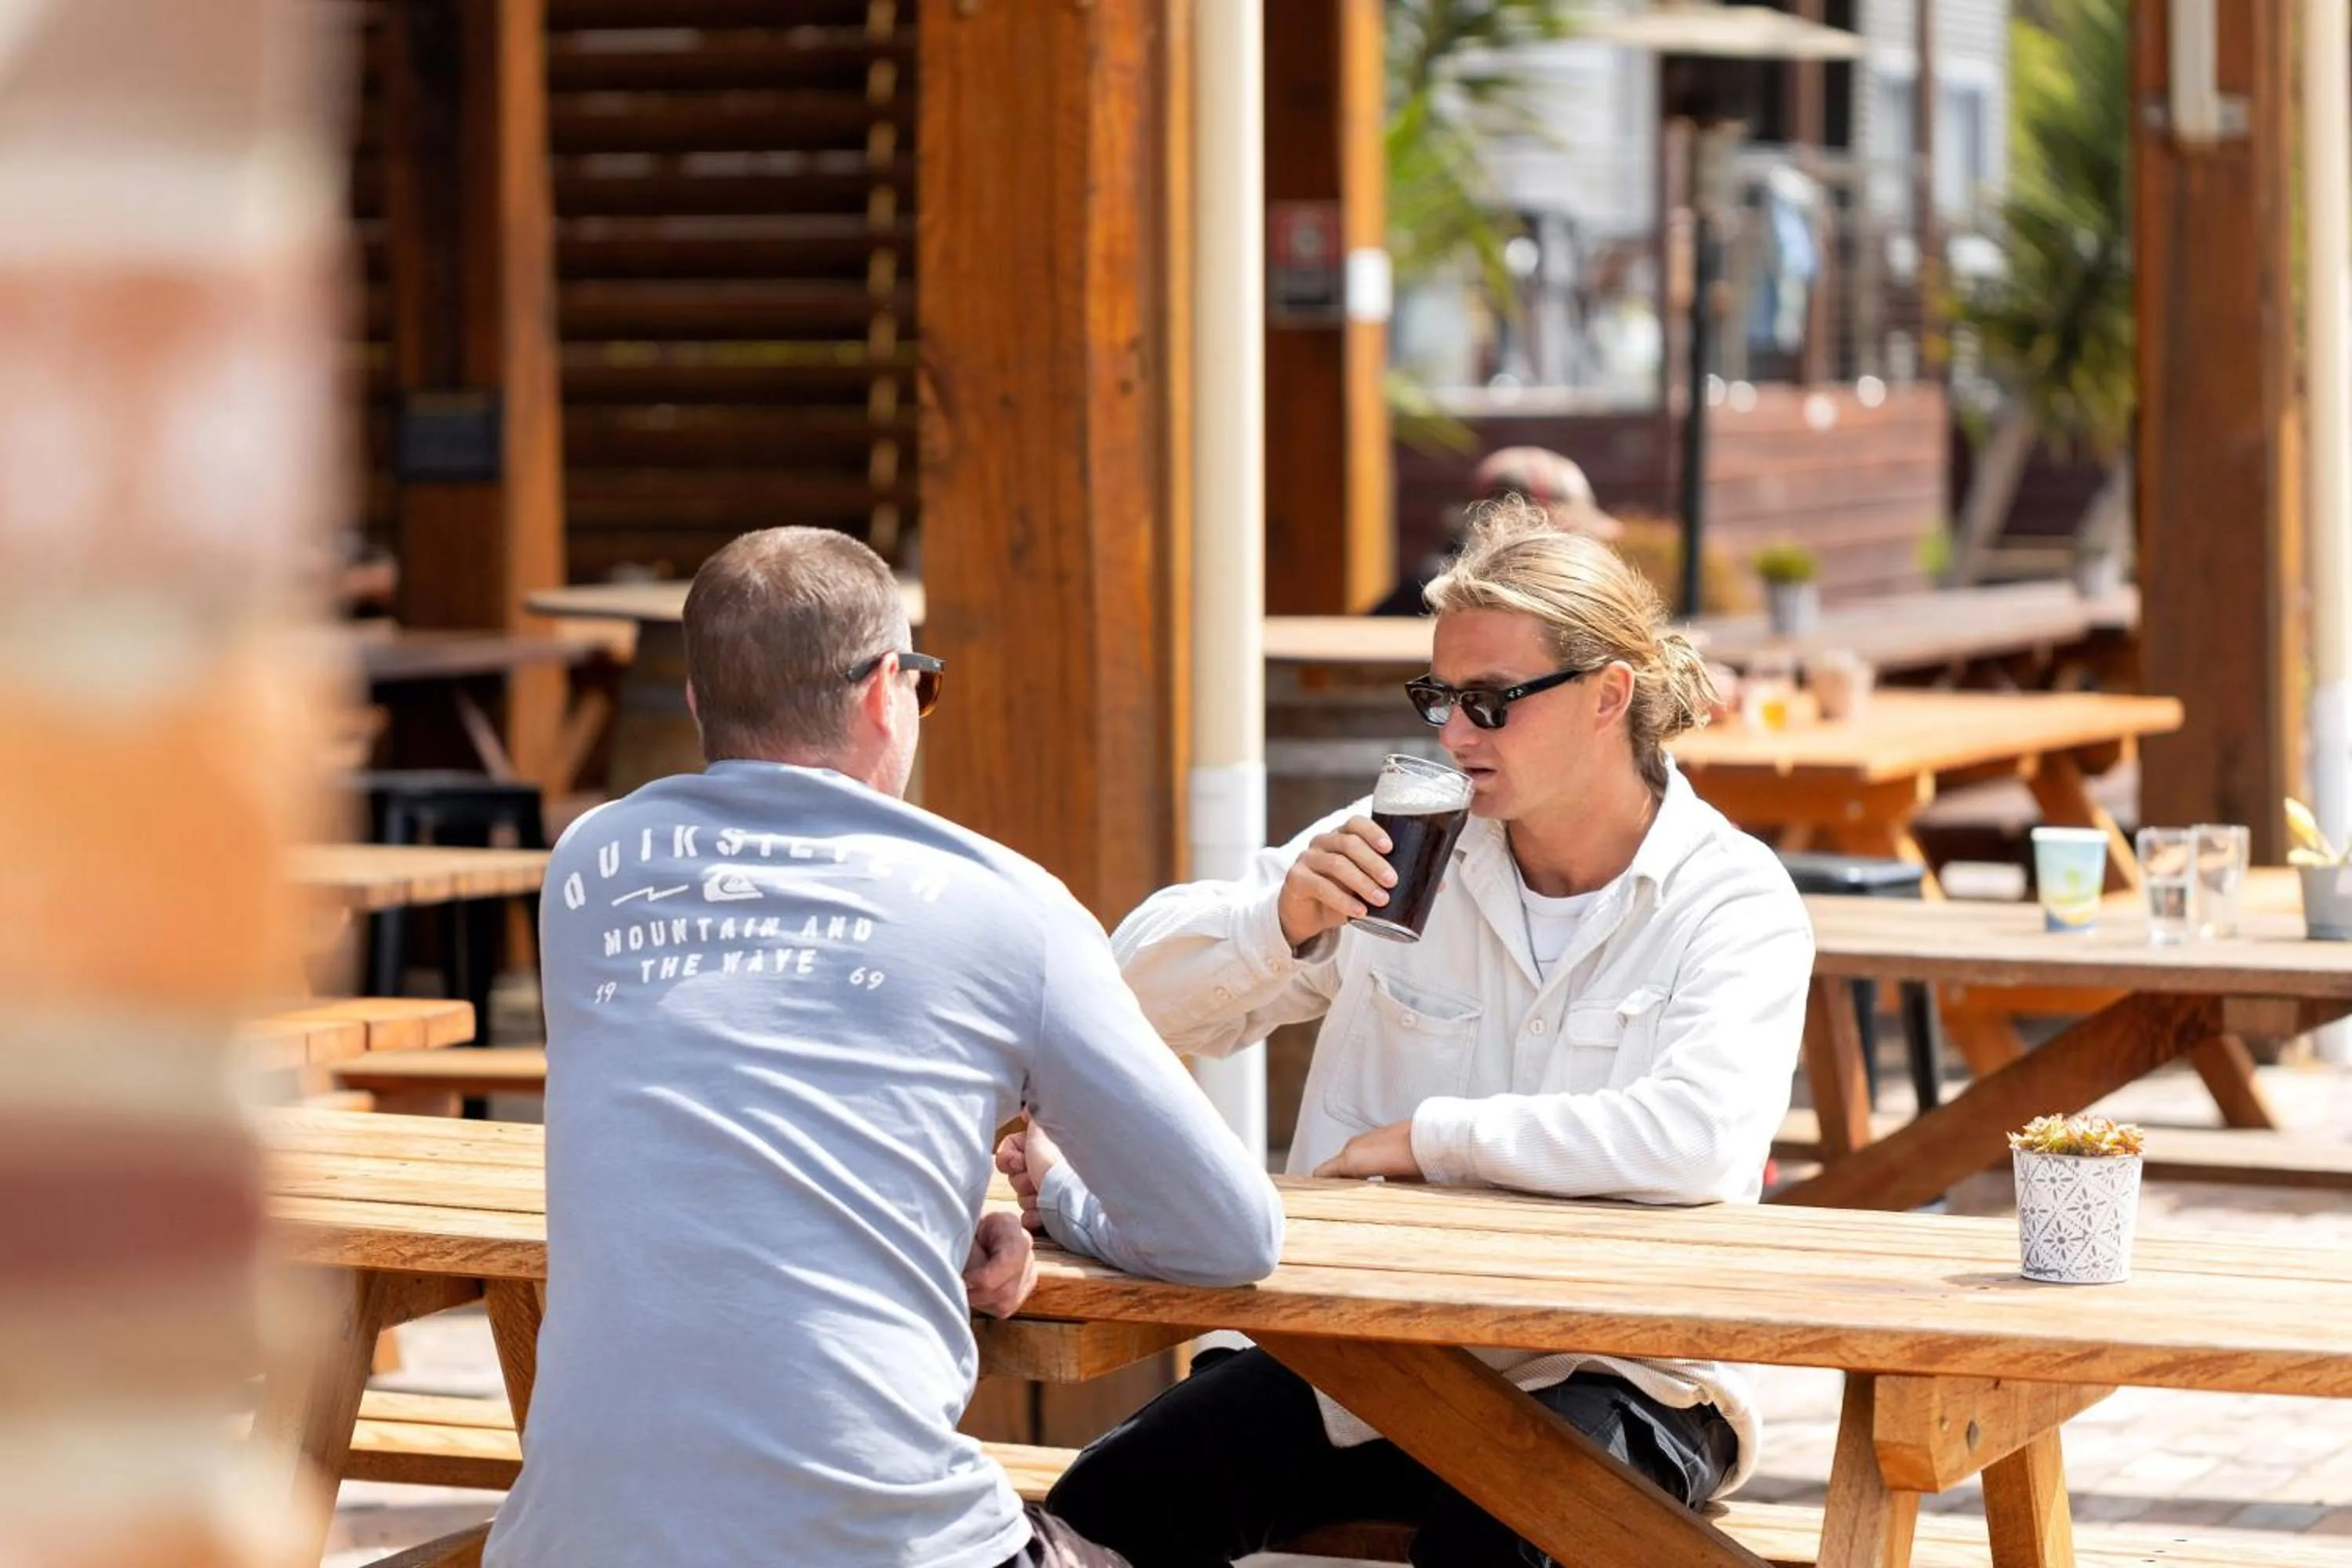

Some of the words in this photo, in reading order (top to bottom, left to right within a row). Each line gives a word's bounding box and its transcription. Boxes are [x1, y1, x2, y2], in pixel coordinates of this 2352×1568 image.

[564, 825, 952, 909] QUIKSILR
[603, 916, 781, 957] MOUNTAIN
[800, 915, 873, 942] AND
[641, 953, 702, 984] THE
[722, 948, 817, 974] WAVE
[849, 967, 885, 990] 69
[594, 982, 617, 1004] 19
